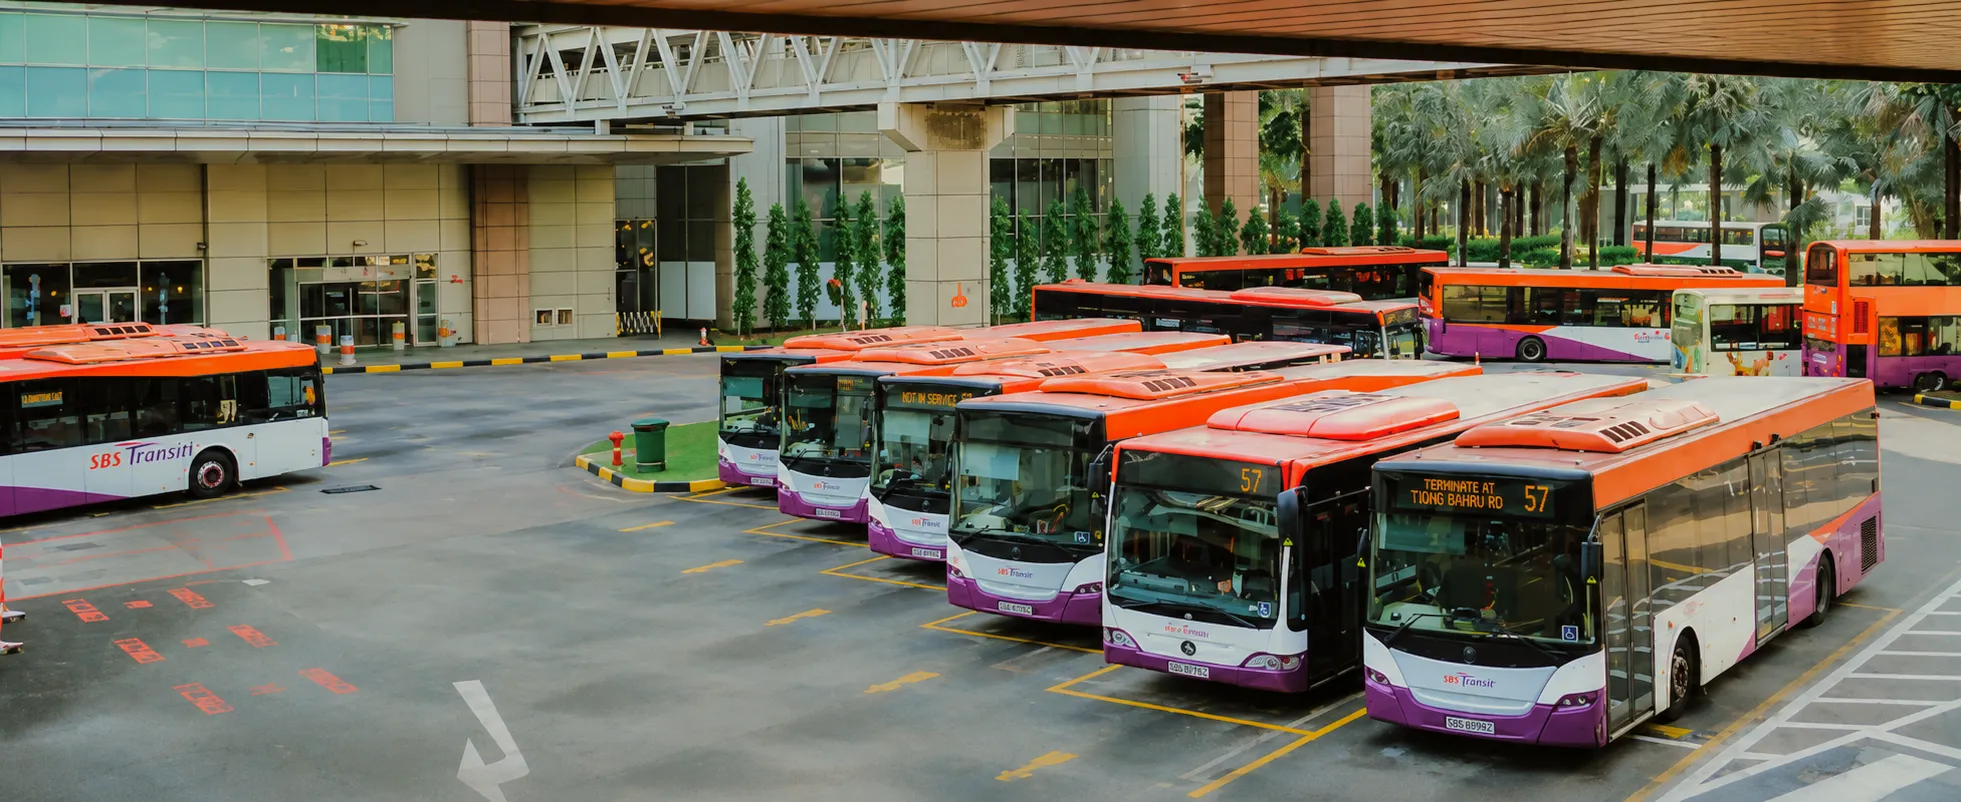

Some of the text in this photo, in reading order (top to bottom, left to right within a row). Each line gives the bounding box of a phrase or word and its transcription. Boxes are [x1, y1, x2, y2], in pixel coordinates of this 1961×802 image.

[902, 392, 916, 404] NOT
[927, 393, 957, 407] SERVICE
[90, 452, 121, 470] SBS
[1240, 467, 1262, 493] 57
[1410, 489, 1503, 509] TIONG BAHRU RD
[1423, 478, 1549, 512] TERMINATE AT 57
[1443, 674, 1496, 688] SBS Transit
[1447, 718, 1464, 728] SBS
